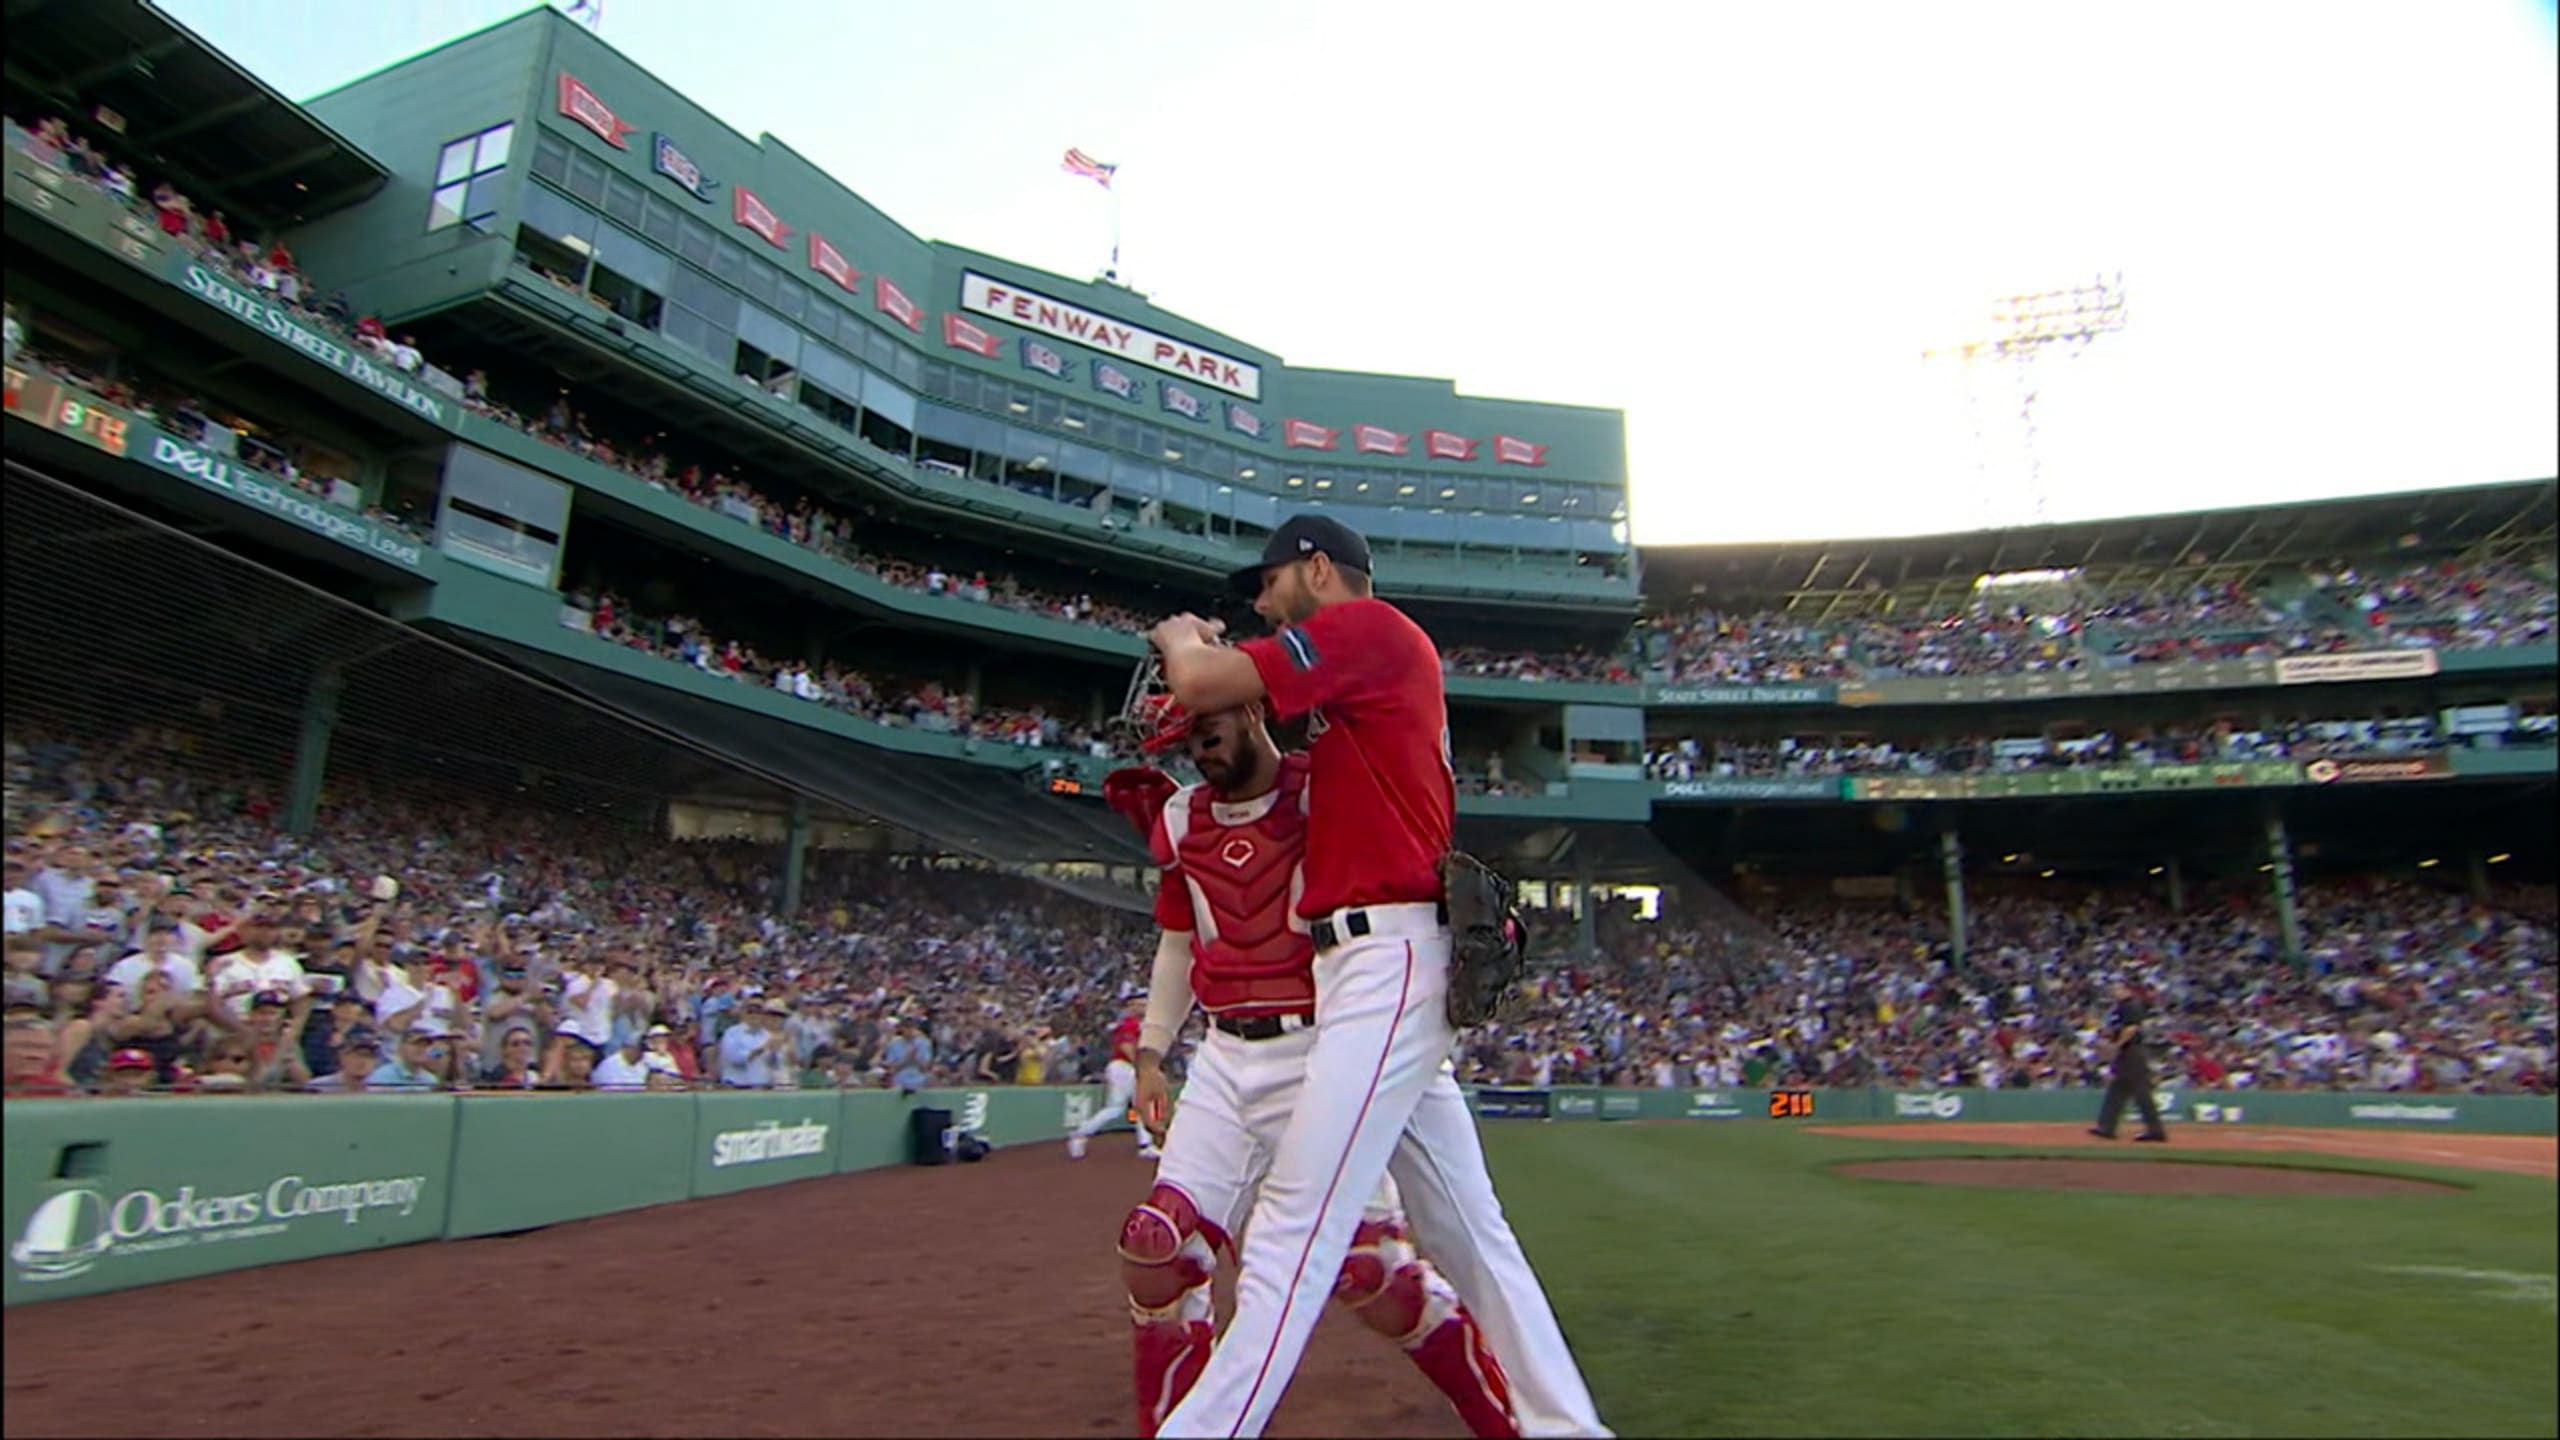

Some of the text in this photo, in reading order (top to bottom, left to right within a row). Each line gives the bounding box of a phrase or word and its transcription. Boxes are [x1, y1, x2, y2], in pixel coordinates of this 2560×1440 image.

[183, 265, 443, 420] STATE STREET PAVILION
[986, 287, 1133, 350] FENWAY
[1153, 341, 1241, 388] PARK
[235, 469, 367, 544] Technologies
[369, 528, 421, 566] Level
[712, 1117, 829, 1167] smartwater
[111, 1175, 427, 1239] Ockers Company
